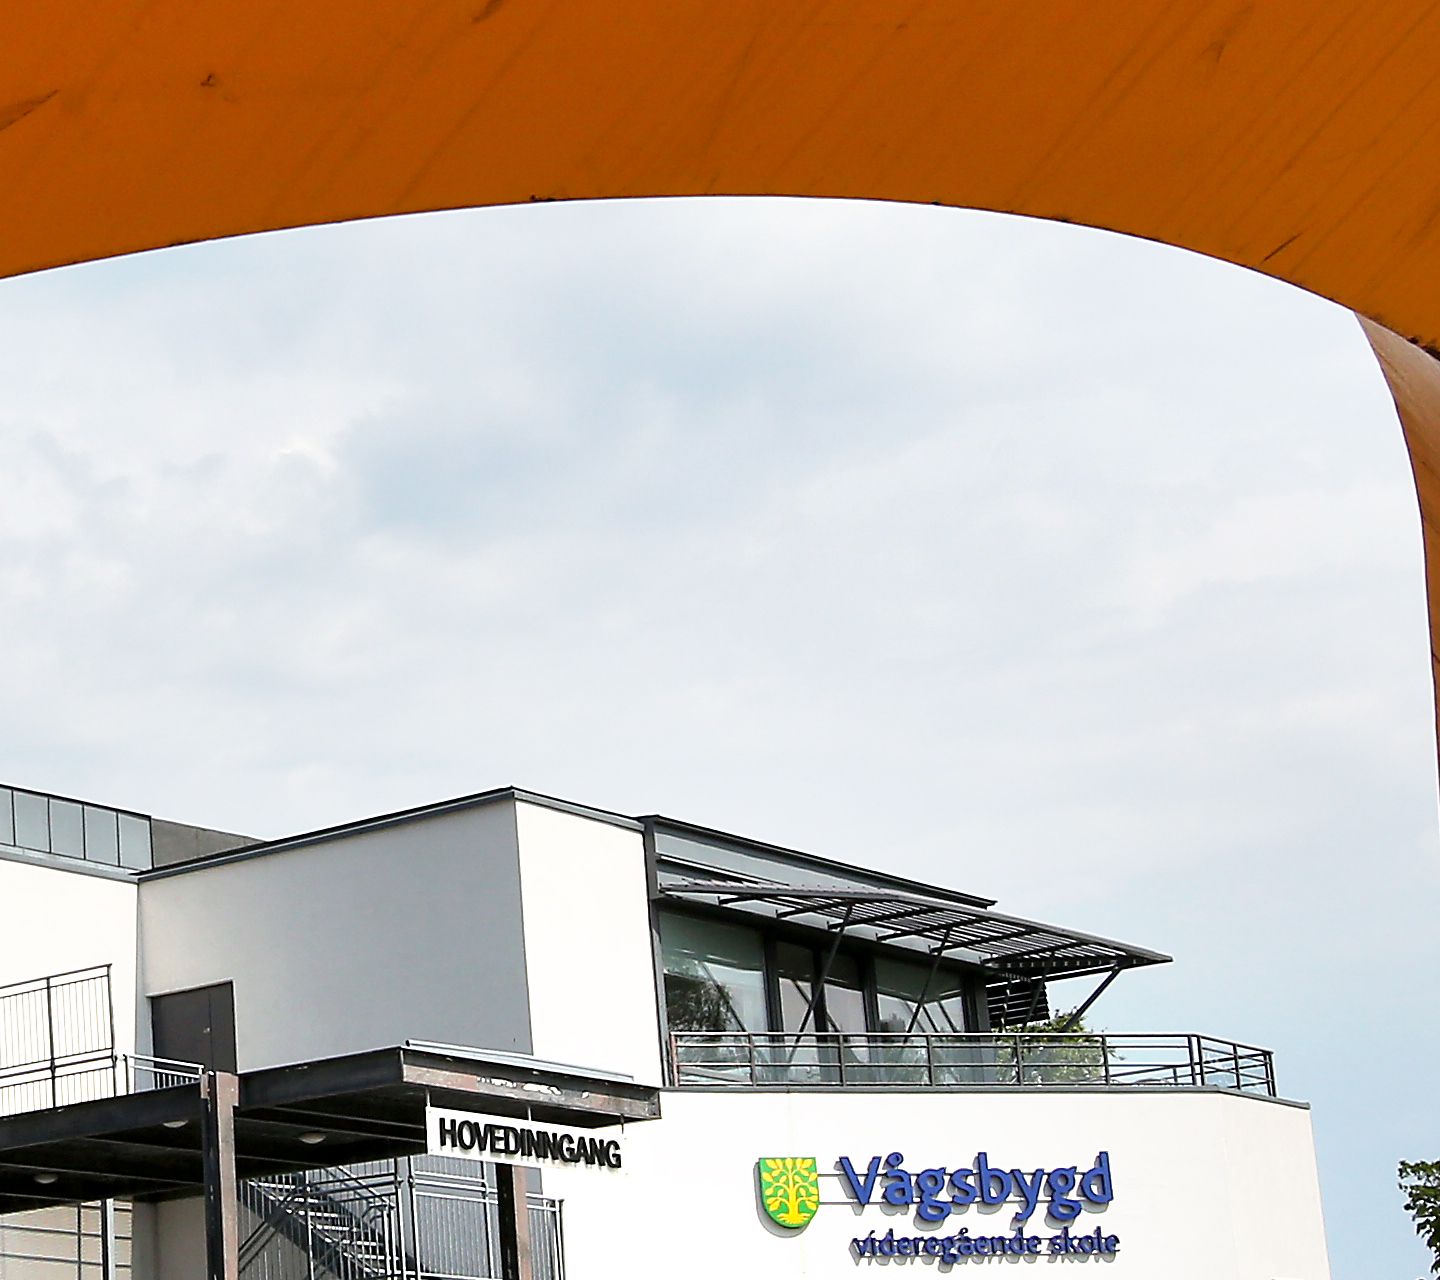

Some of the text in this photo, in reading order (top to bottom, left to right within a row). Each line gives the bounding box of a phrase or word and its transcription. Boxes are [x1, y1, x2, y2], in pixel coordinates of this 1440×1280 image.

[439, 1117, 622, 1169] HOVEDINNGANG
[838, 1151, 1114, 1221] Vågsbygd
[851, 1225, 1121, 1265] videregående skole
